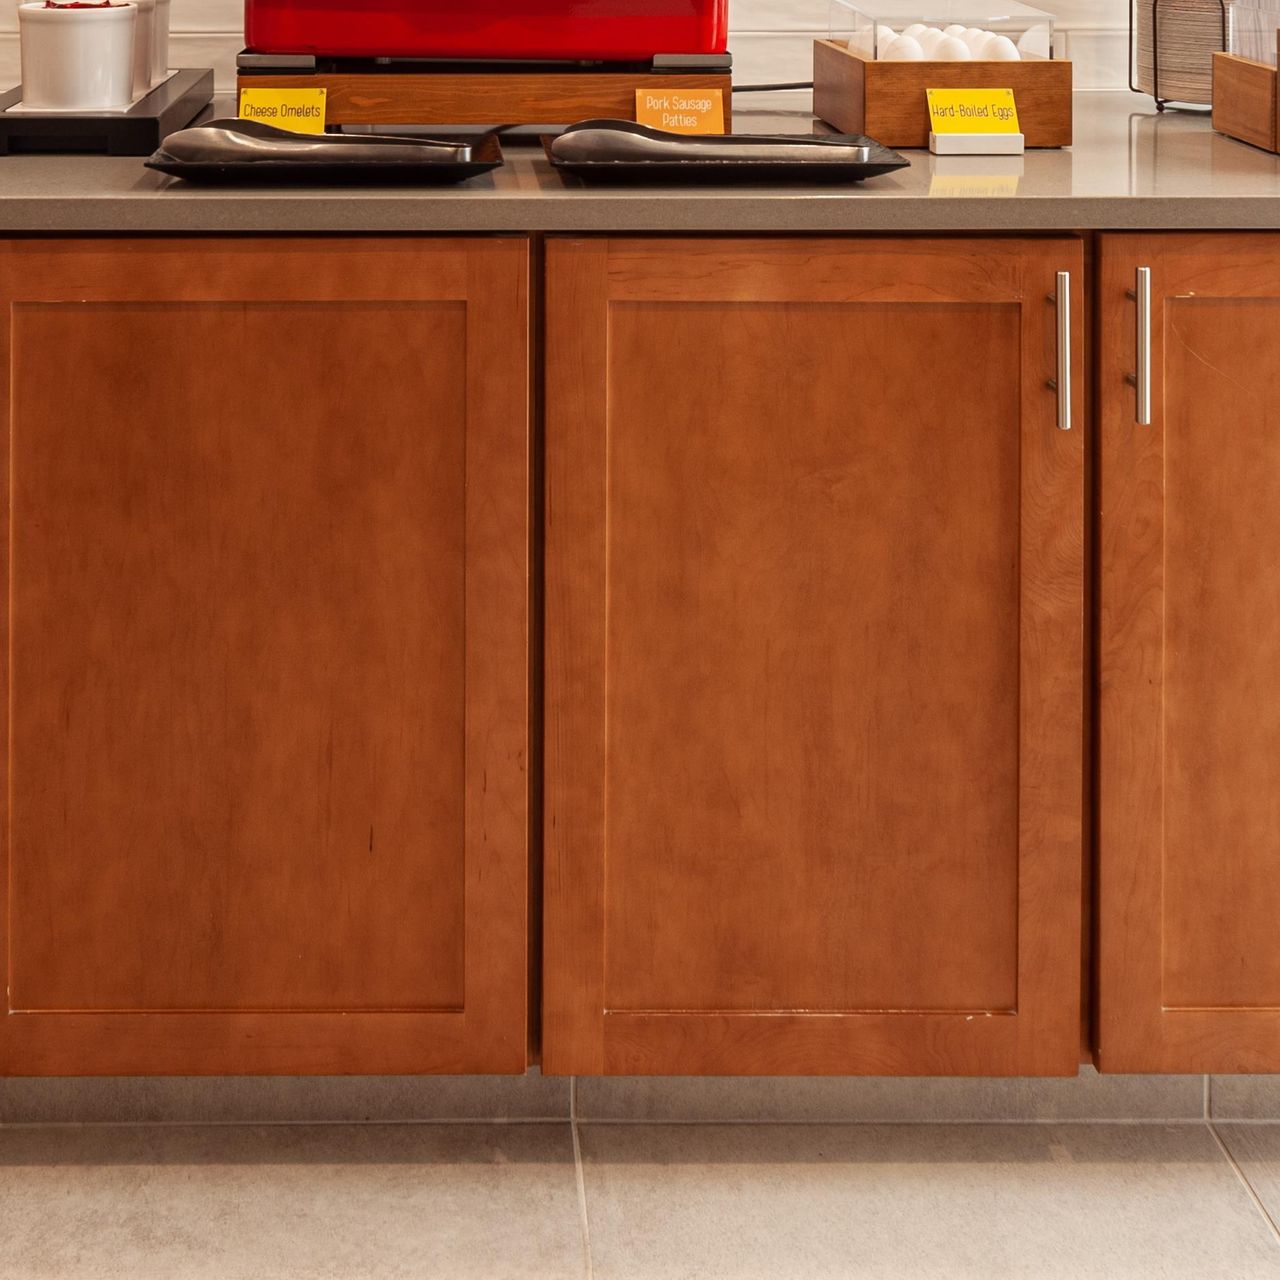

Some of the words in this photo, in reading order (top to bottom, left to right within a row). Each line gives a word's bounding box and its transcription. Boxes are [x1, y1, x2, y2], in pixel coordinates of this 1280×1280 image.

[244, 104, 277, 117] Cheese
[281, 104, 320, 117] Omelets
[646, 96, 670, 110] Pork
[673, 96, 711, 112] Sausage
[932, 104, 988, 117] Hard-Boiled
[992, 104, 1014, 120] Eggs
[663, 113, 697, 127] Patties
